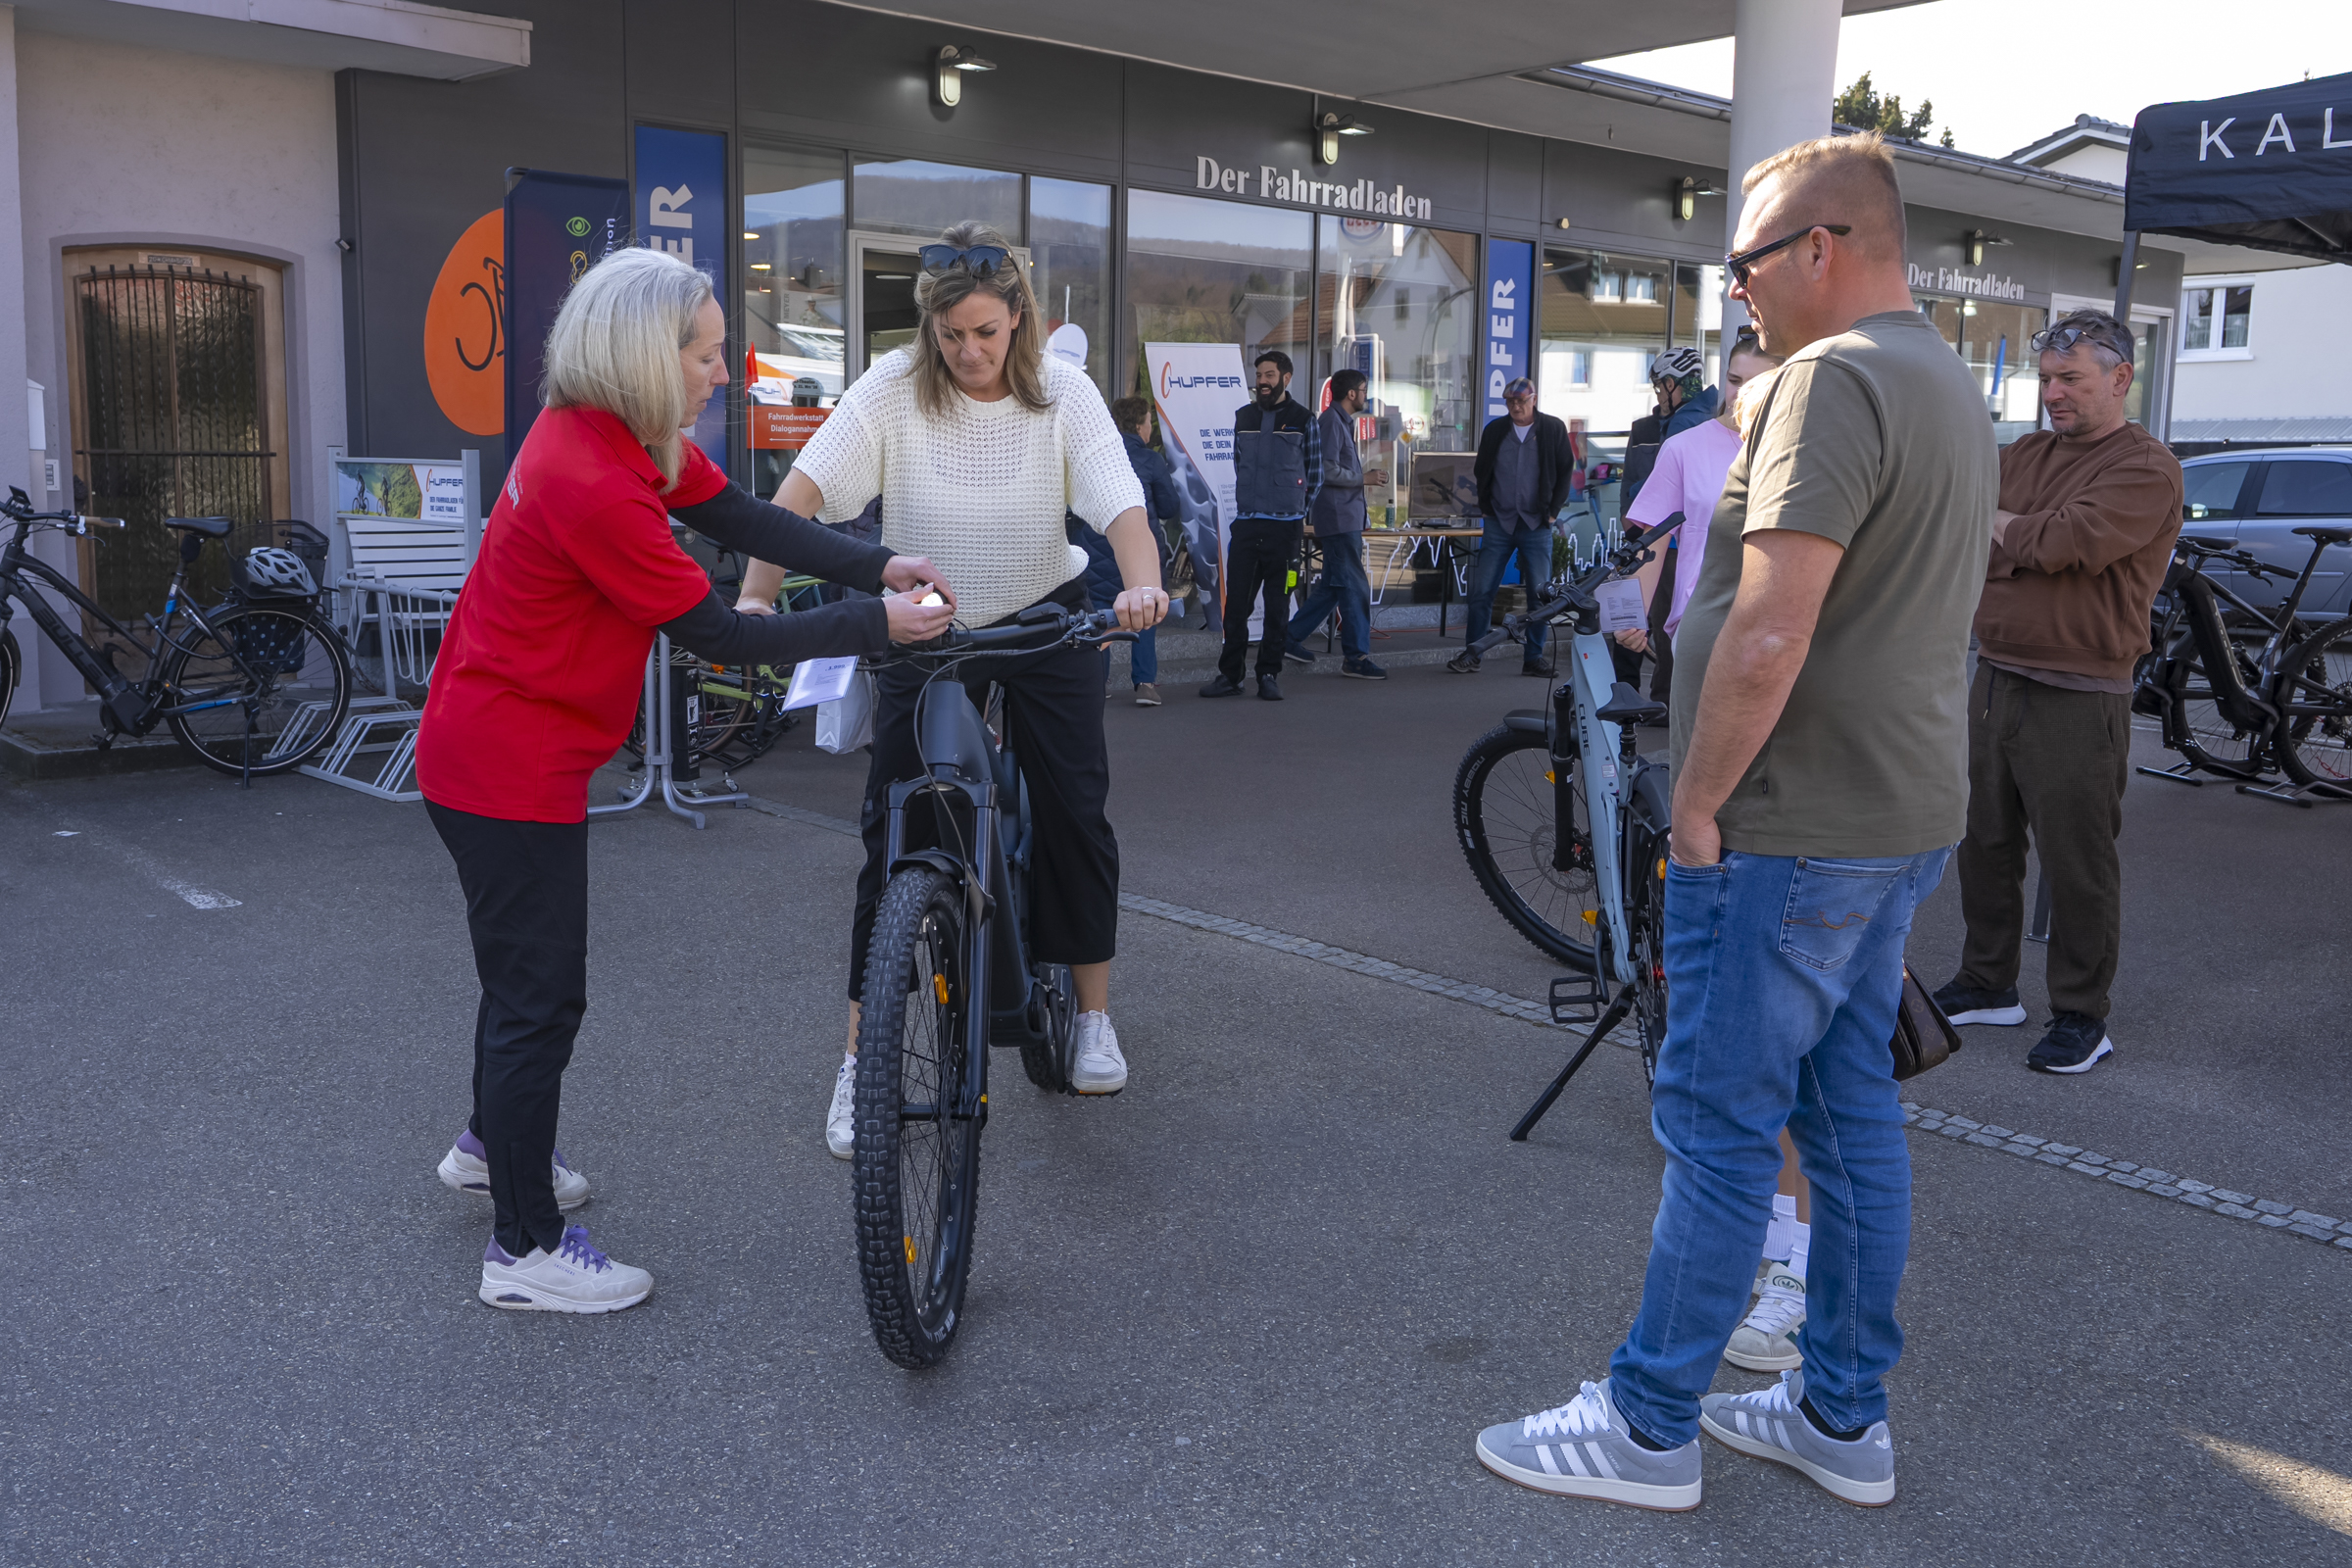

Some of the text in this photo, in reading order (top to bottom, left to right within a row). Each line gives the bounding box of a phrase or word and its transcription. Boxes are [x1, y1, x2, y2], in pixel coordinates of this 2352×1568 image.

[2199, 107, 2352, 162] KAL
[1196, 155, 1432, 220] Der Fahrradladen
[1907, 263, 2025, 300] Der Fahrradladen
[1168, 375, 1242, 388] HUPFER
[767, 413, 824, 421] Fahrradwerkstatt
[770, 424, 819, 434] Dialogannahm
[1200, 428, 1211, 437] DIE
[1215, 440, 1232, 449] DEIN
[34, 607, 104, 681] BULLS
[1579, 703, 1591, 758] CUBE
[1460, 801, 1469, 825] NIC
